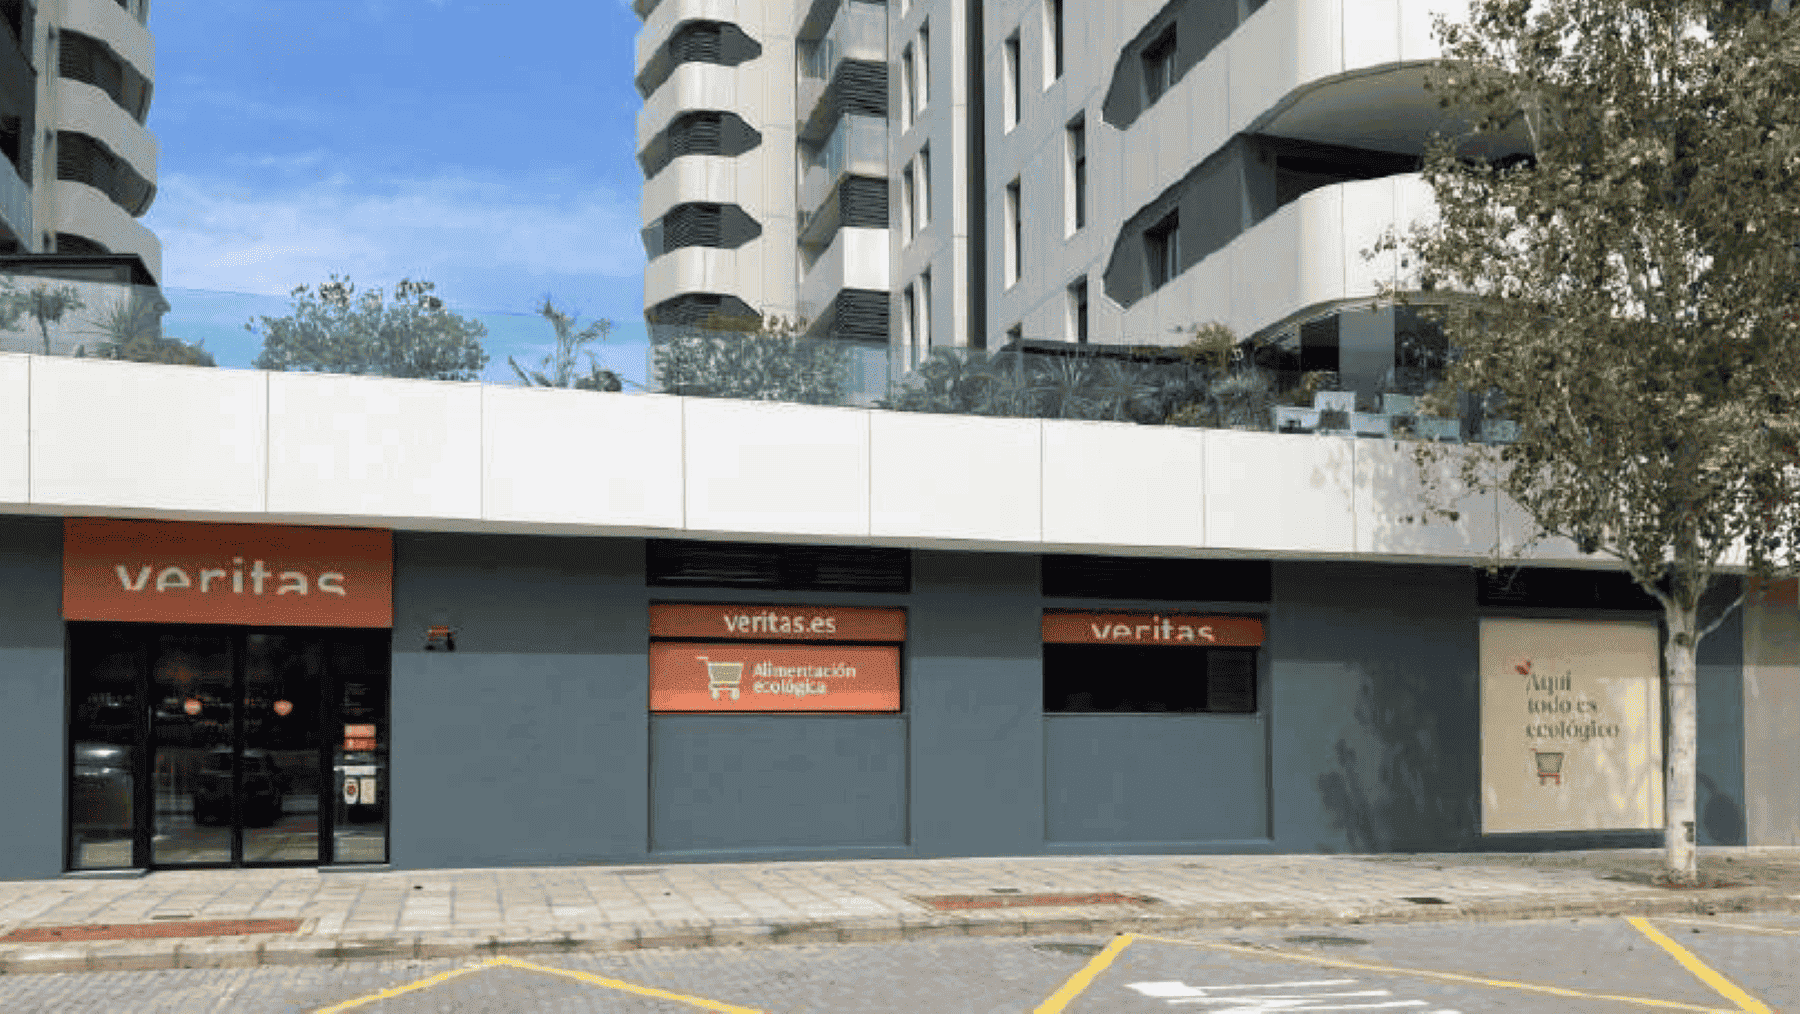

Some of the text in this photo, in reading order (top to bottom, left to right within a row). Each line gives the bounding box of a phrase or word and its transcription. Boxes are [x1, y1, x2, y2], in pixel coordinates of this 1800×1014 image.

[116, 556, 346, 597] veritas
[724, 611, 836, 634] veritas.es
[1091, 615, 1216, 642] veritas
[753, 661, 857, 678] Alimentación
[752, 678, 827, 699] ecológica
[1527, 695, 1598, 714] todo es
[1525, 720, 1621, 742] ecológico
